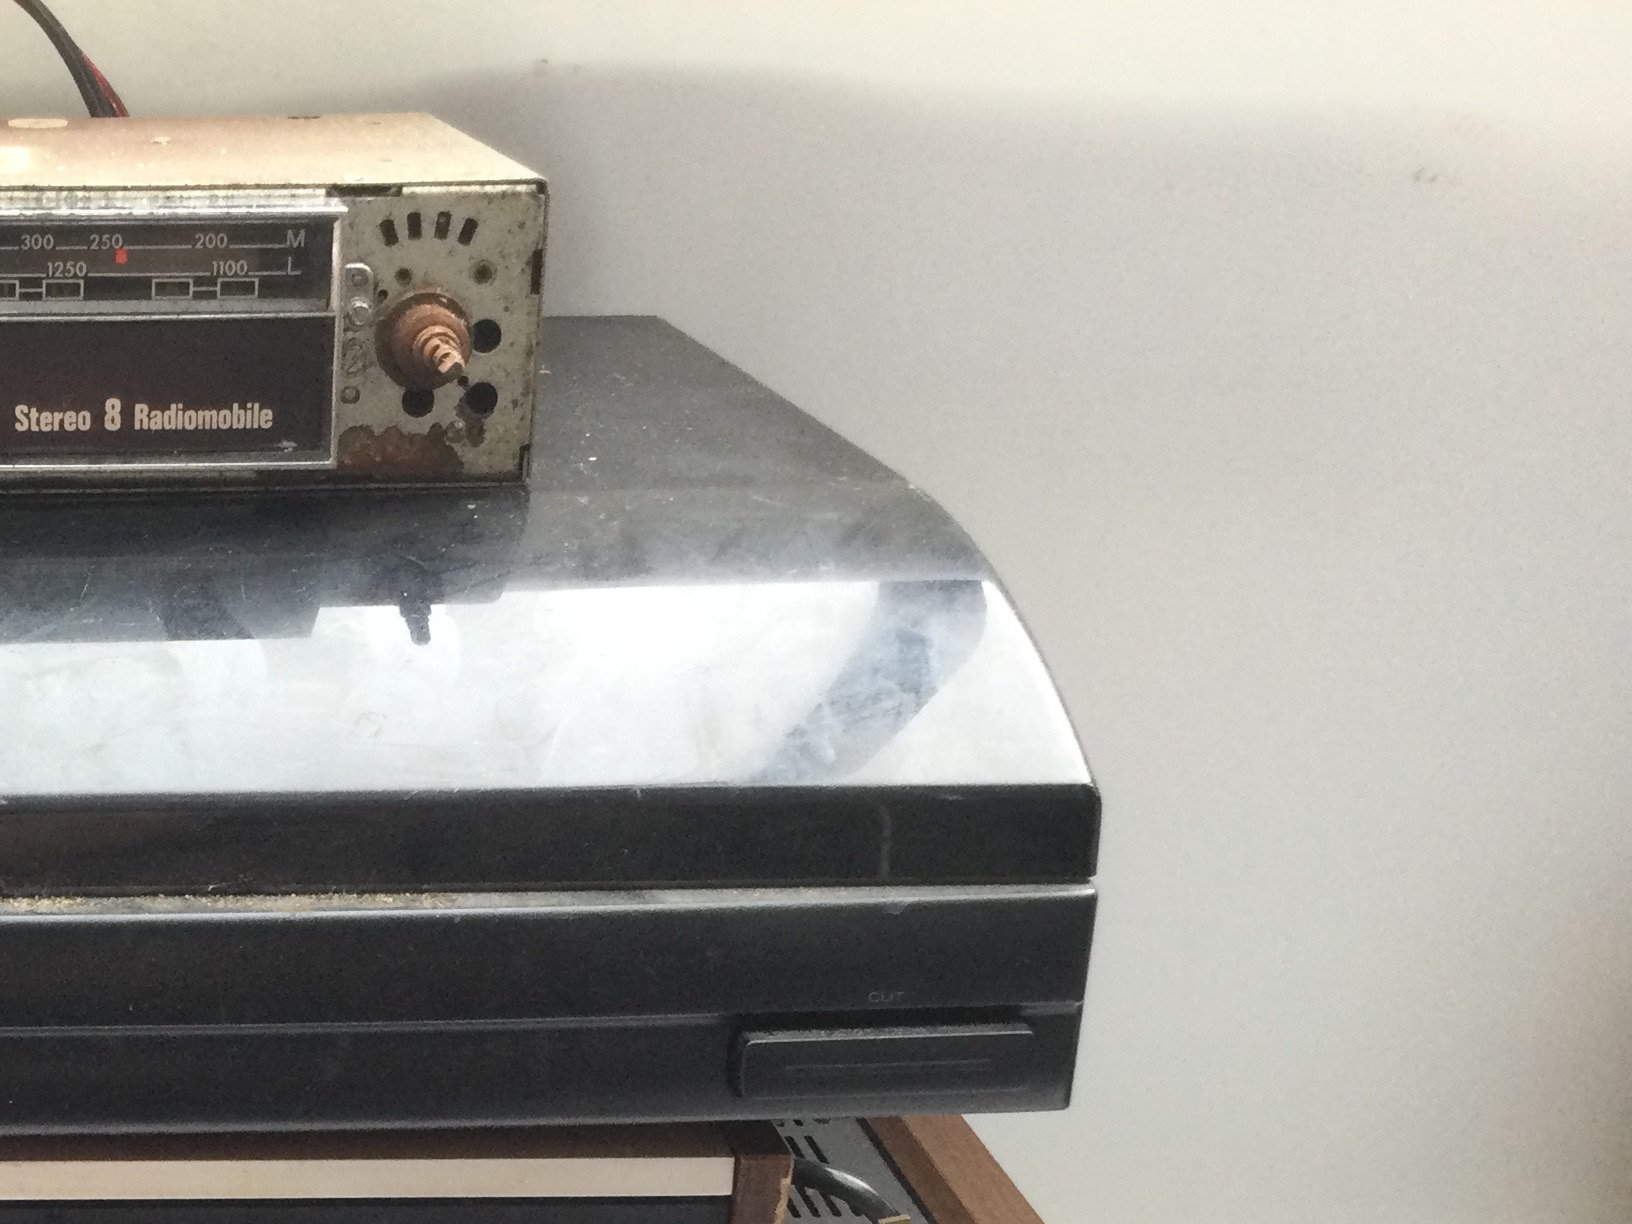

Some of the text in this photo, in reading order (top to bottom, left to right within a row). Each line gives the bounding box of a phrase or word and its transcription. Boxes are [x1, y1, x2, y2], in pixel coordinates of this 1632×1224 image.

[21, 234, 54, 250] 300
[90, 234, 122, 249] 250
[195, 233, 227, 248] 200
[286, 231, 305, 247] M
[48, 261, 86, 277] 1250
[213, 260, 248, 276] 1100
[287, 259, 295, 273] L
[15, 398, 273, 431] Stereo 8 Radiomobile
